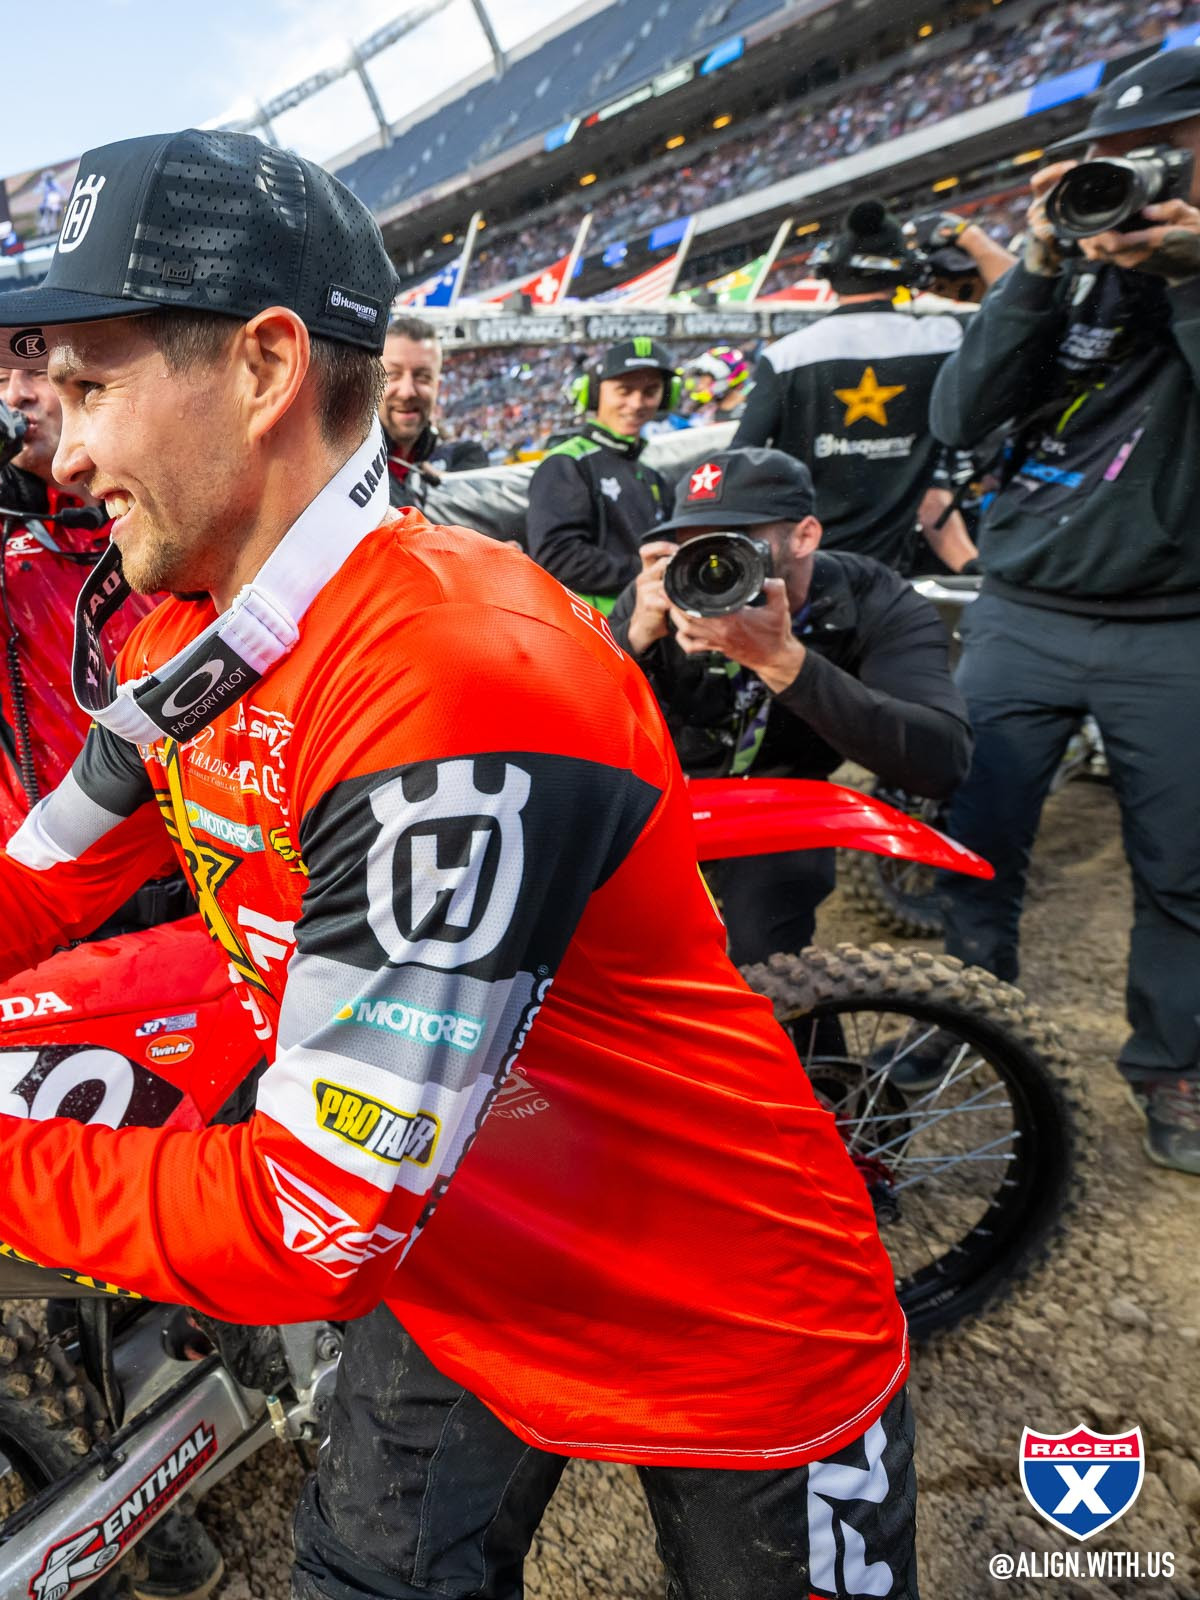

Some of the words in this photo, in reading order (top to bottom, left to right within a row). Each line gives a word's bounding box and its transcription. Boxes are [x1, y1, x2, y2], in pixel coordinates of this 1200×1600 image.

[340, 296, 378, 318] Husqvarna
[171, 692, 220, 735] FACTORY
[215, 667, 247, 696] PILOT
[198, 808, 261, 850] MOTOREX
[356, 1000, 482, 1051] MOTORE
[150, 1045, 176, 1058] Twin
[175, 1041, 191, 1054] Air
